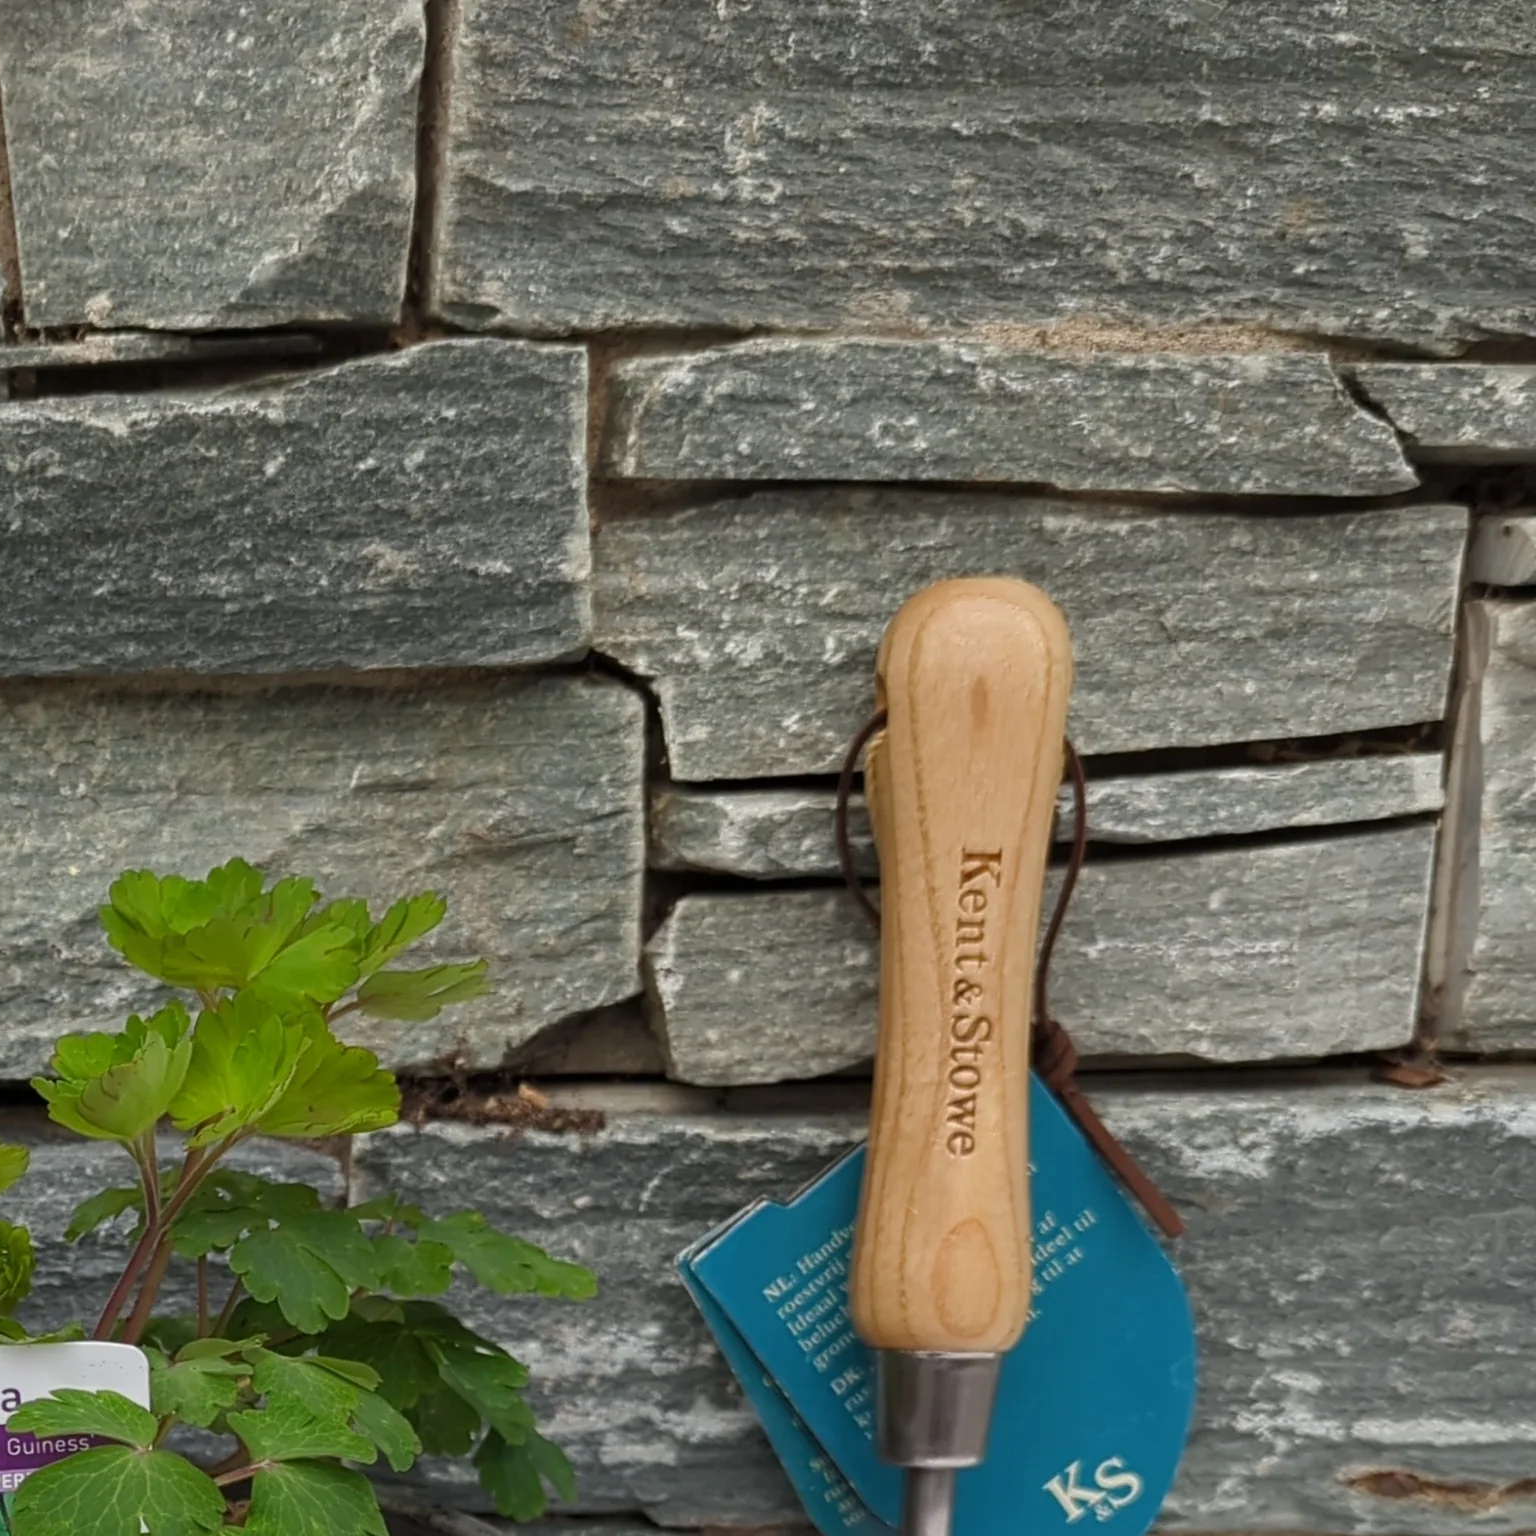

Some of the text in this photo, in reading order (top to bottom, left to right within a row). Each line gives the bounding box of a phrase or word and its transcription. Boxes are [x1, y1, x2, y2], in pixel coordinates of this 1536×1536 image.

[946, 847, 1003, 1159] Kent & Stowe
